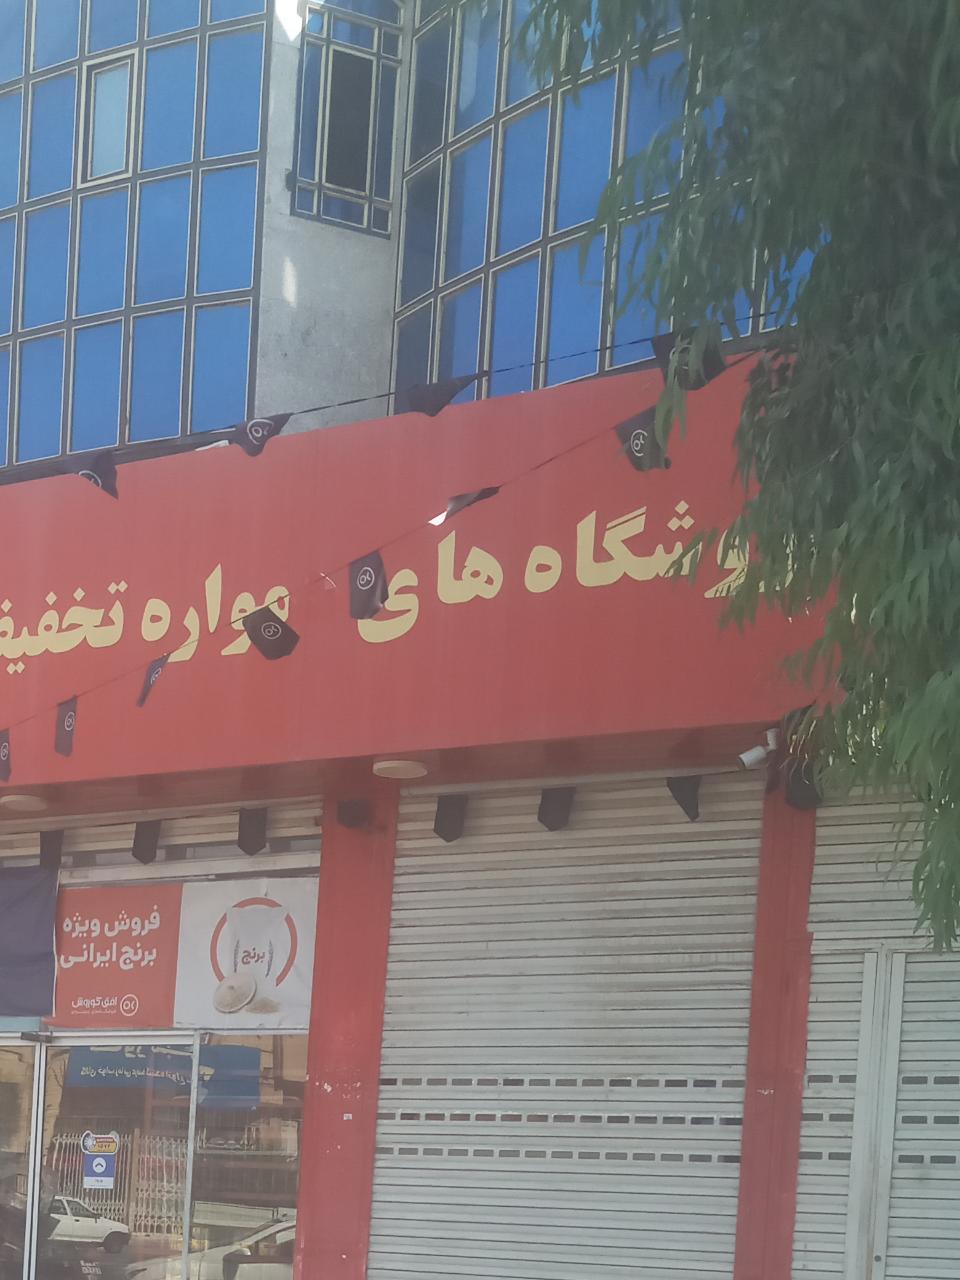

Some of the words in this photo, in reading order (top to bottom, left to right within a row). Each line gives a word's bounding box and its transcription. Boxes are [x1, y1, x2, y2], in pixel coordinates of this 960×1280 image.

[62, 911, 101, 938] ویژه
[103, 905, 161, 937] فروش
[59, 939, 117, 969] ایرانی
[119, 945, 157, 970] برنج
[241, 947, 265, 965] برنج
[101, 996, 118, 1008] افق
